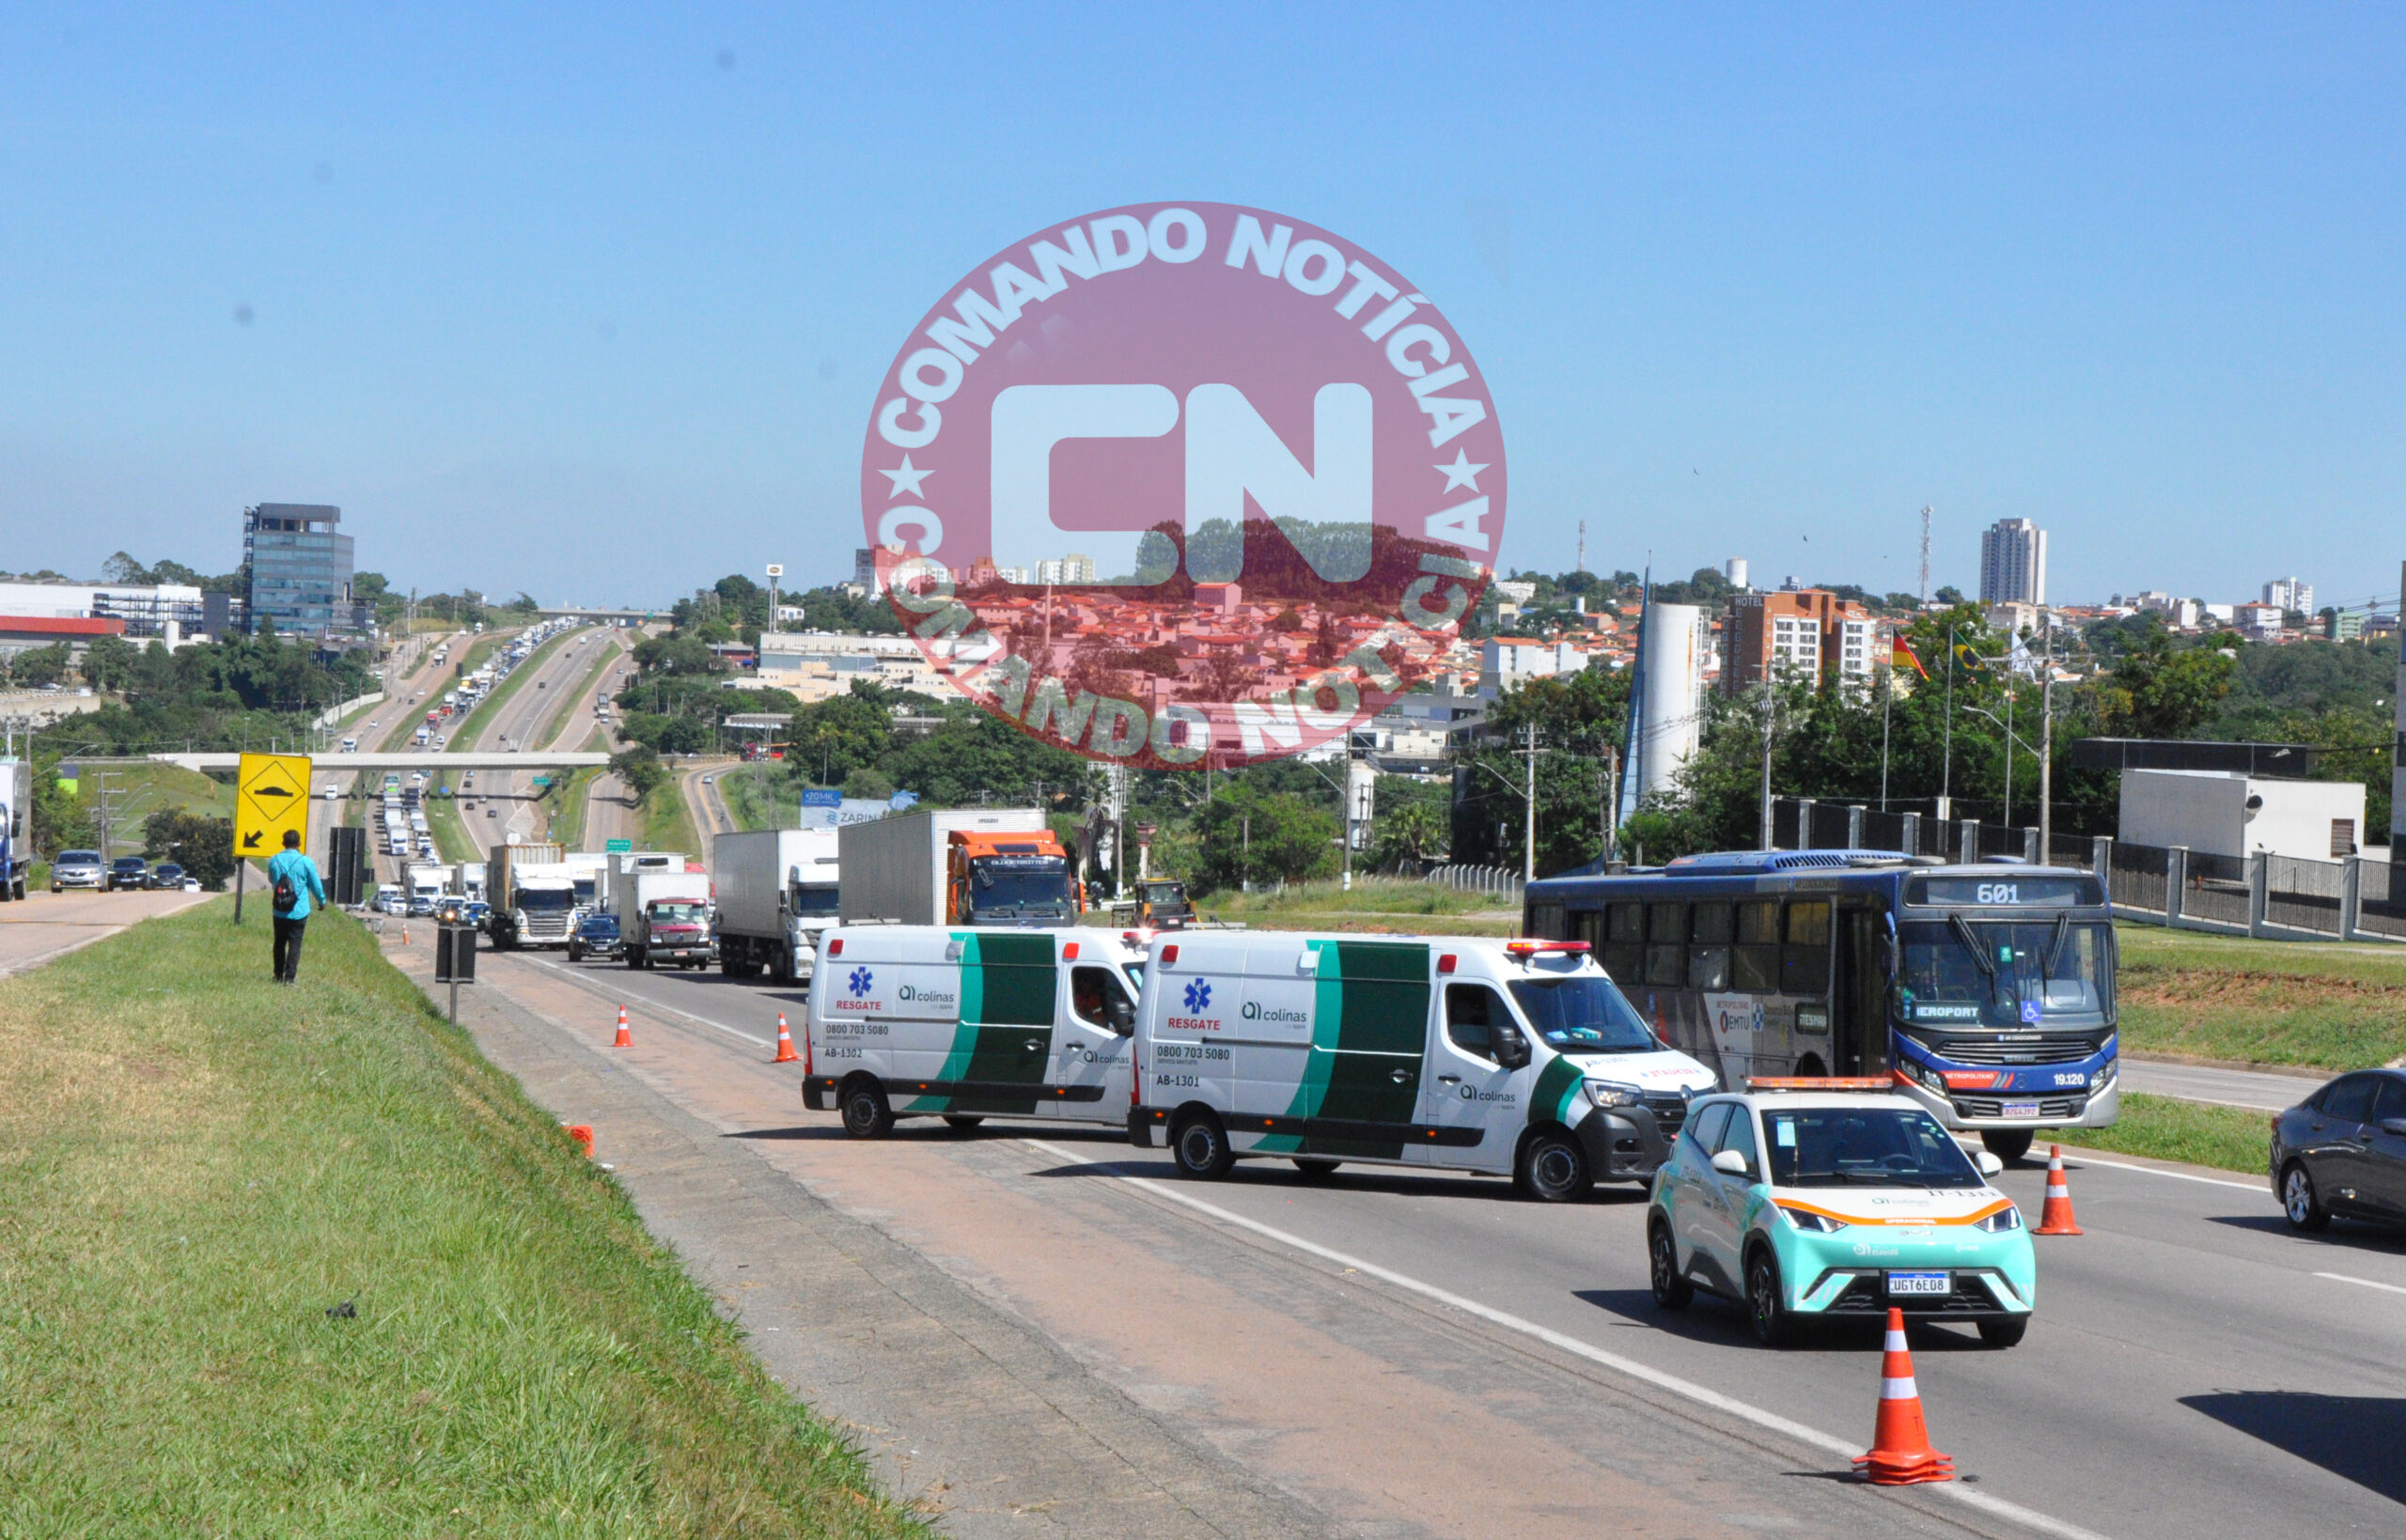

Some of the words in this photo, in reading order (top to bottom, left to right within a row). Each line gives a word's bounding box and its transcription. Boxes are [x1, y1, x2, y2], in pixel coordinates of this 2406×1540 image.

[1735, 596, 1763, 607] HOTEL
[1976, 883, 2021, 904] 601
[916, 990, 955, 1003] colinas
[836, 1000, 882, 1011] RESGATE
[1263, 1008, 1307, 1022] colinas
[826, 1024, 848, 1034] 0800
[850, 1024, 866, 1034] 703
[867, 1025, 889, 1035] 5080
[1167, 1017, 1221, 1031] RESGATE
[1728, 1015, 1750, 1031] EMTU
[824, 1048, 863, 1059] AB-1302
[1099, 1054, 1130, 1065] colinas
[1157, 1045, 1181, 1058] 0800
[1184, 1047, 1203, 1059] 703
[1205, 1048, 1230, 1061] 5080
[1156, 1074, 1200, 1087] AB-1301
[1945, 1072, 1994, 1081] METROPOLITANO
[2053, 1072, 2086, 1086] 19.120
[1478, 1090, 1516, 1103] colinas
[1894, 1279, 1945, 1292] UGT6E08
